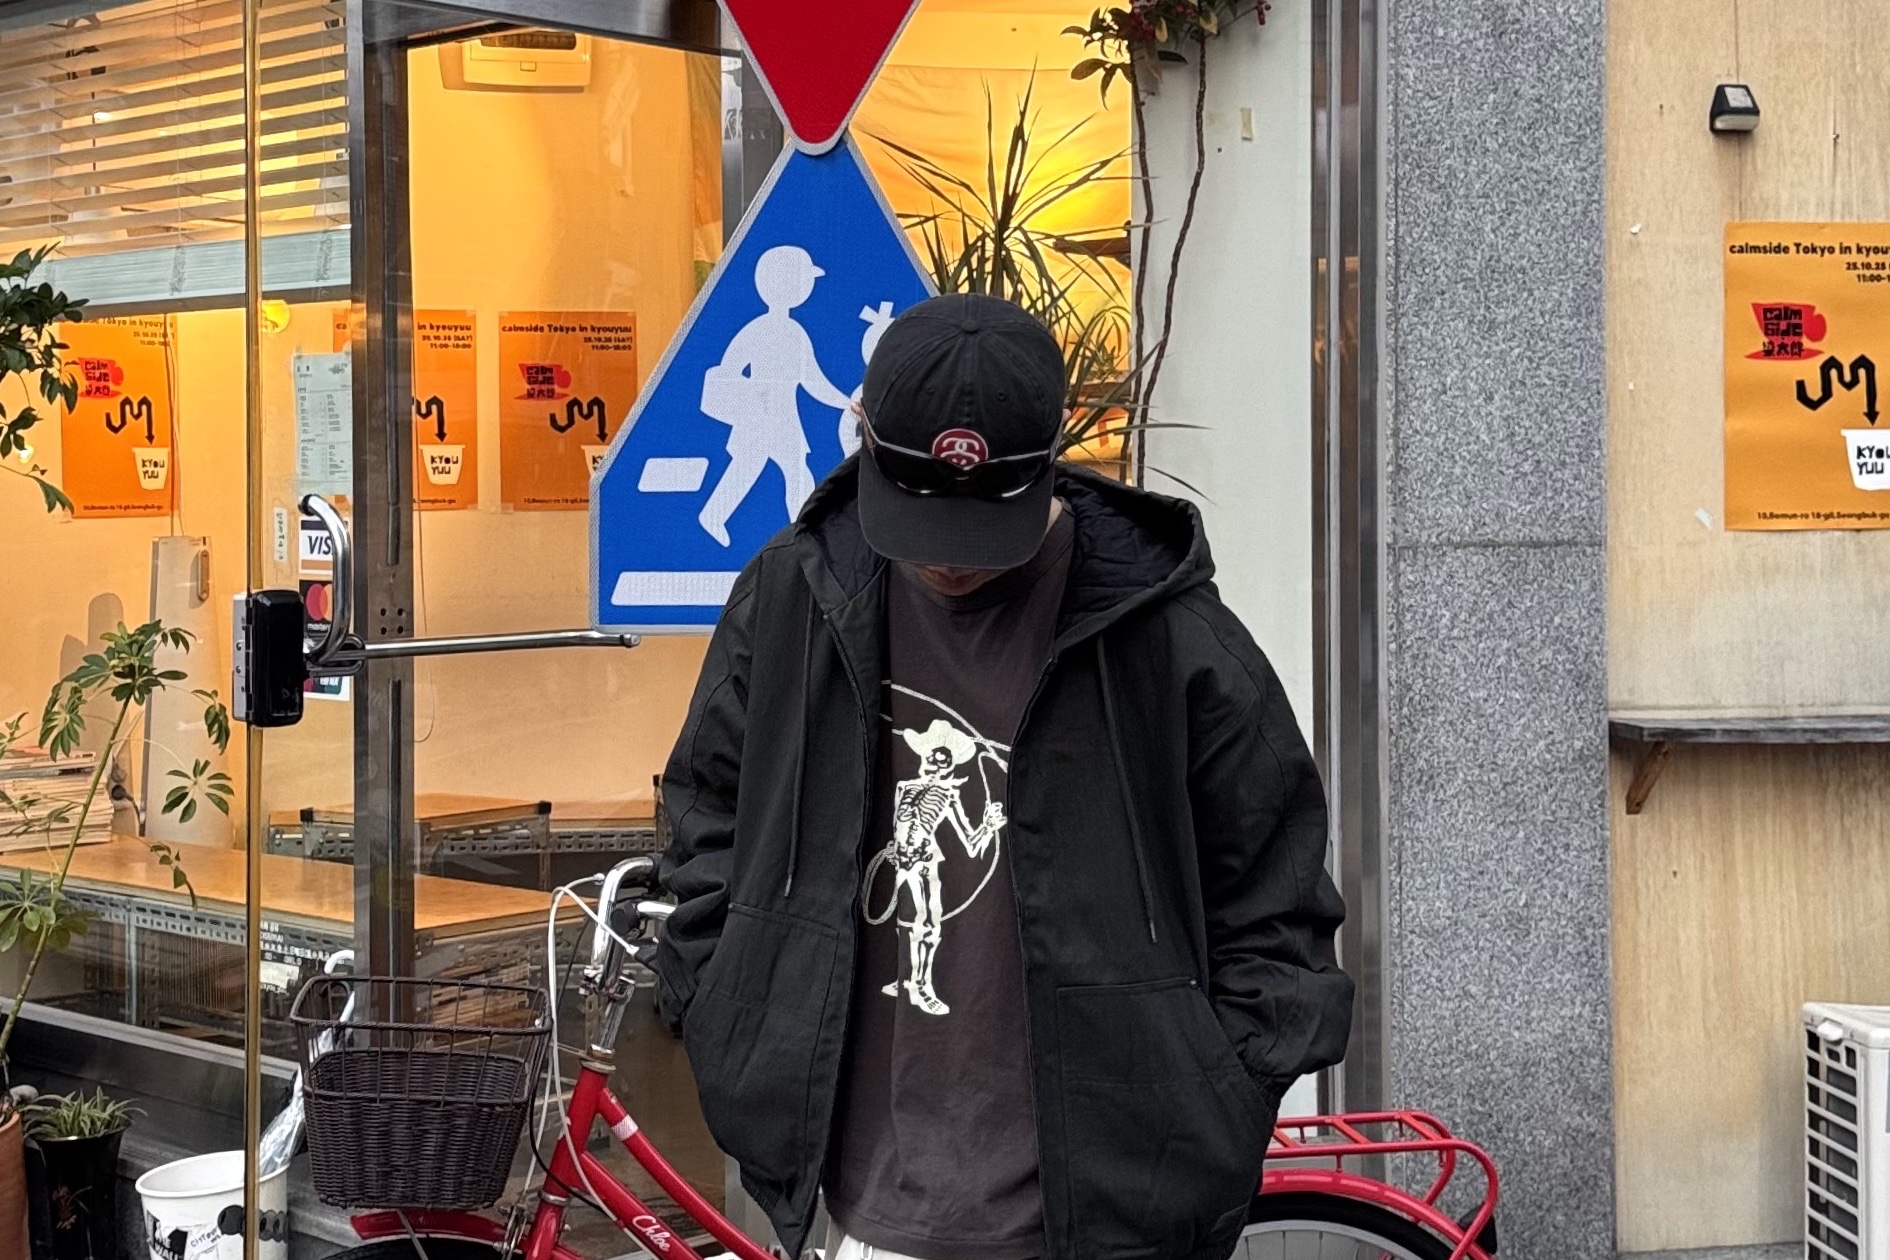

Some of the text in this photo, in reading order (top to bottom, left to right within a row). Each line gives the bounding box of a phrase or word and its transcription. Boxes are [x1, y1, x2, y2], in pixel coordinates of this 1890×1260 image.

[1729, 242, 1890, 258] calmside Tokyo in kyou
[501, 323, 632, 334] calmside Tokyo in kyouyuu
[430, 455, 459, 464] KYOU
[431, 466, 451, 475] YUU
[1857, 462, 1884, 475] YUU
[308, 536, 334, 555] VIS
